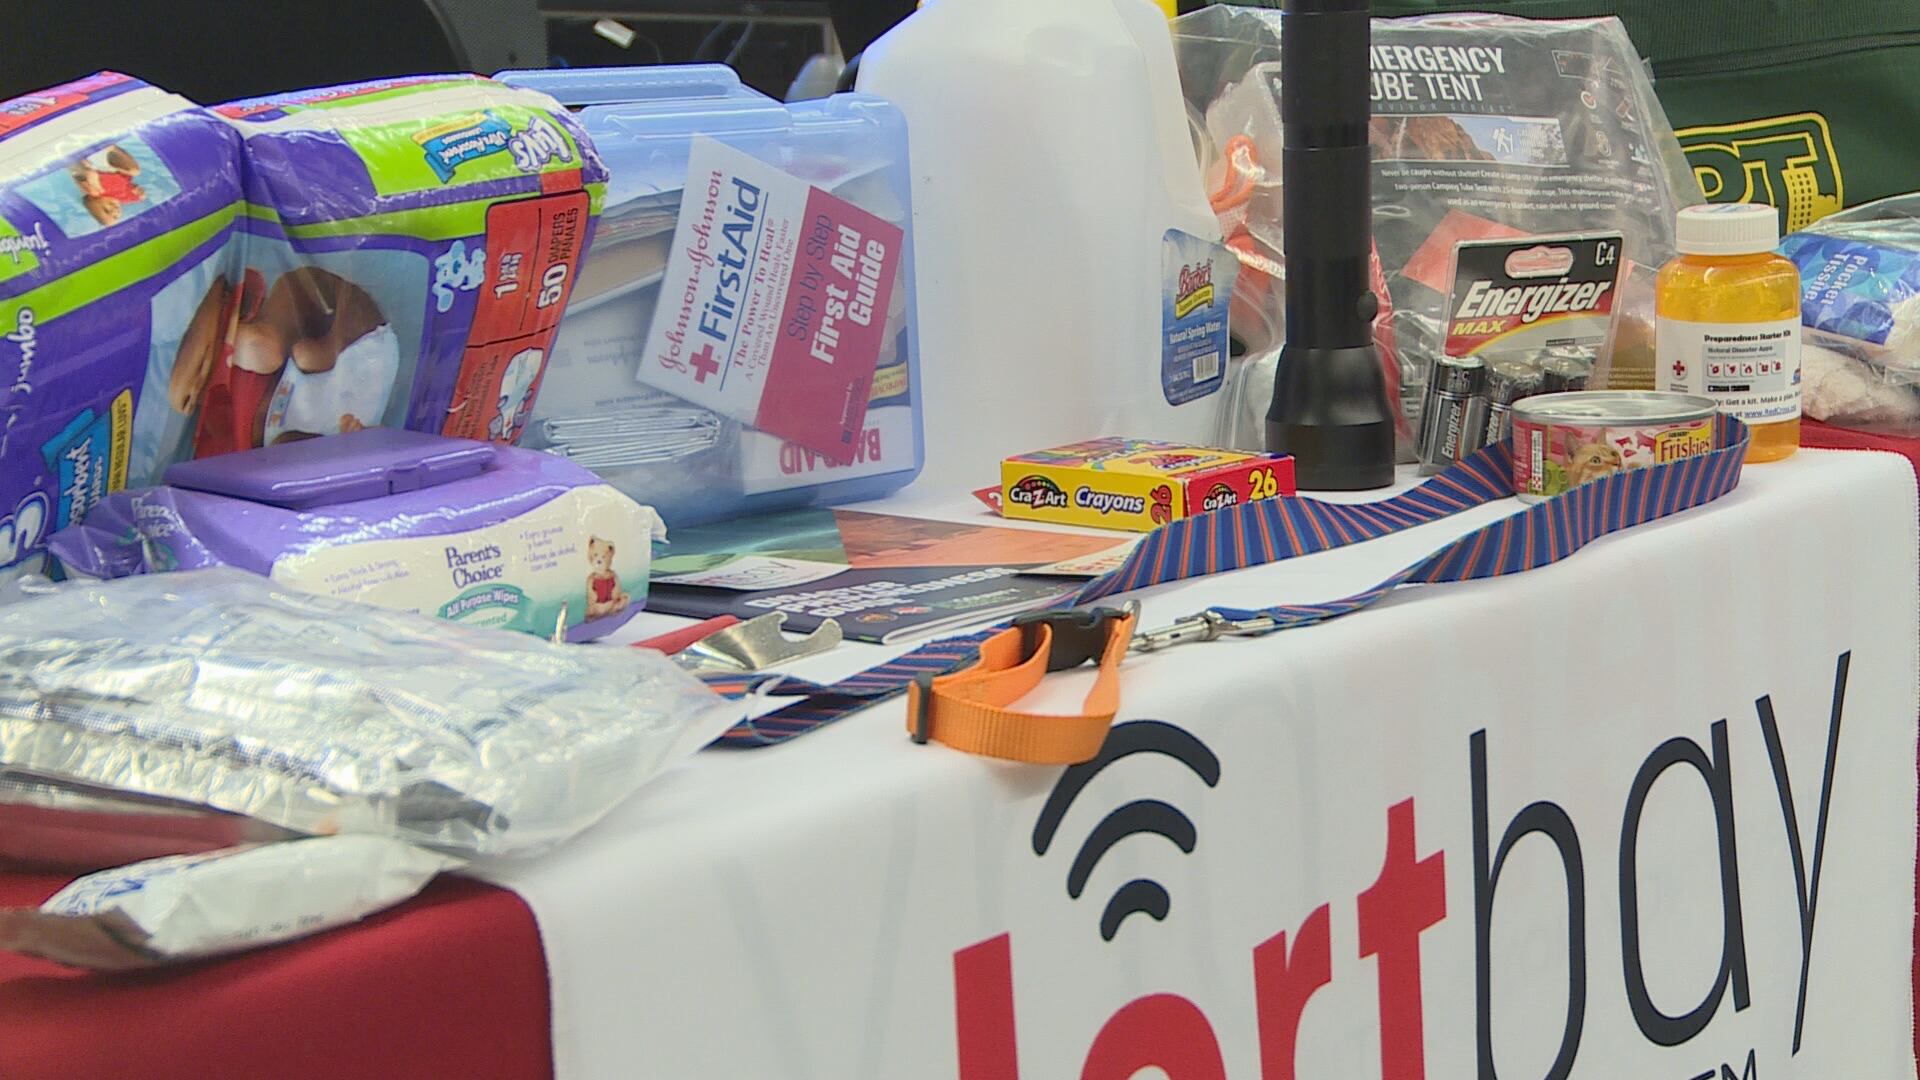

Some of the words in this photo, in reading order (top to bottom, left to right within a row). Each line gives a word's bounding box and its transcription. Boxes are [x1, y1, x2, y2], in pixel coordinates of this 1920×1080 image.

[1370, 45, 1505, 73] MERGENCY
[1370, 72, 1418, 100] UBE
[1420, 74, 1483, 101] TENT
[807, 214, 834, 261] Step
[1595, 241, 1615, 267] C4
[537, 263, 568, 310] 50
[800, 263, 824, 291] by
[847, 239, 886, 327] Guide
[810, 283, 849, 364] First
[830, 224, 862, 280] Aid
[1456, 277, 1612, 323] Energizer
[734, 338, 750, 368] The
[742, 288, 761, 336] Power
[754, 267, 768, 285] To
[788, 295, 817, 341] Step
[1452, 320, 1507, 336] MAX
[1704, 334, 1758, 343] Preparedness
[1760, 332, 1782, 340] Starter
[1441, 401, 1461, 459] Energizer
[1248, 467, 1278, 500] 26
[1075, 487, 1145, 514] Crayons
[1150, 484, 1173, 524] 26
[445, 544, 502, 568] Parent's
[452, 565, 503, 589] Choice
